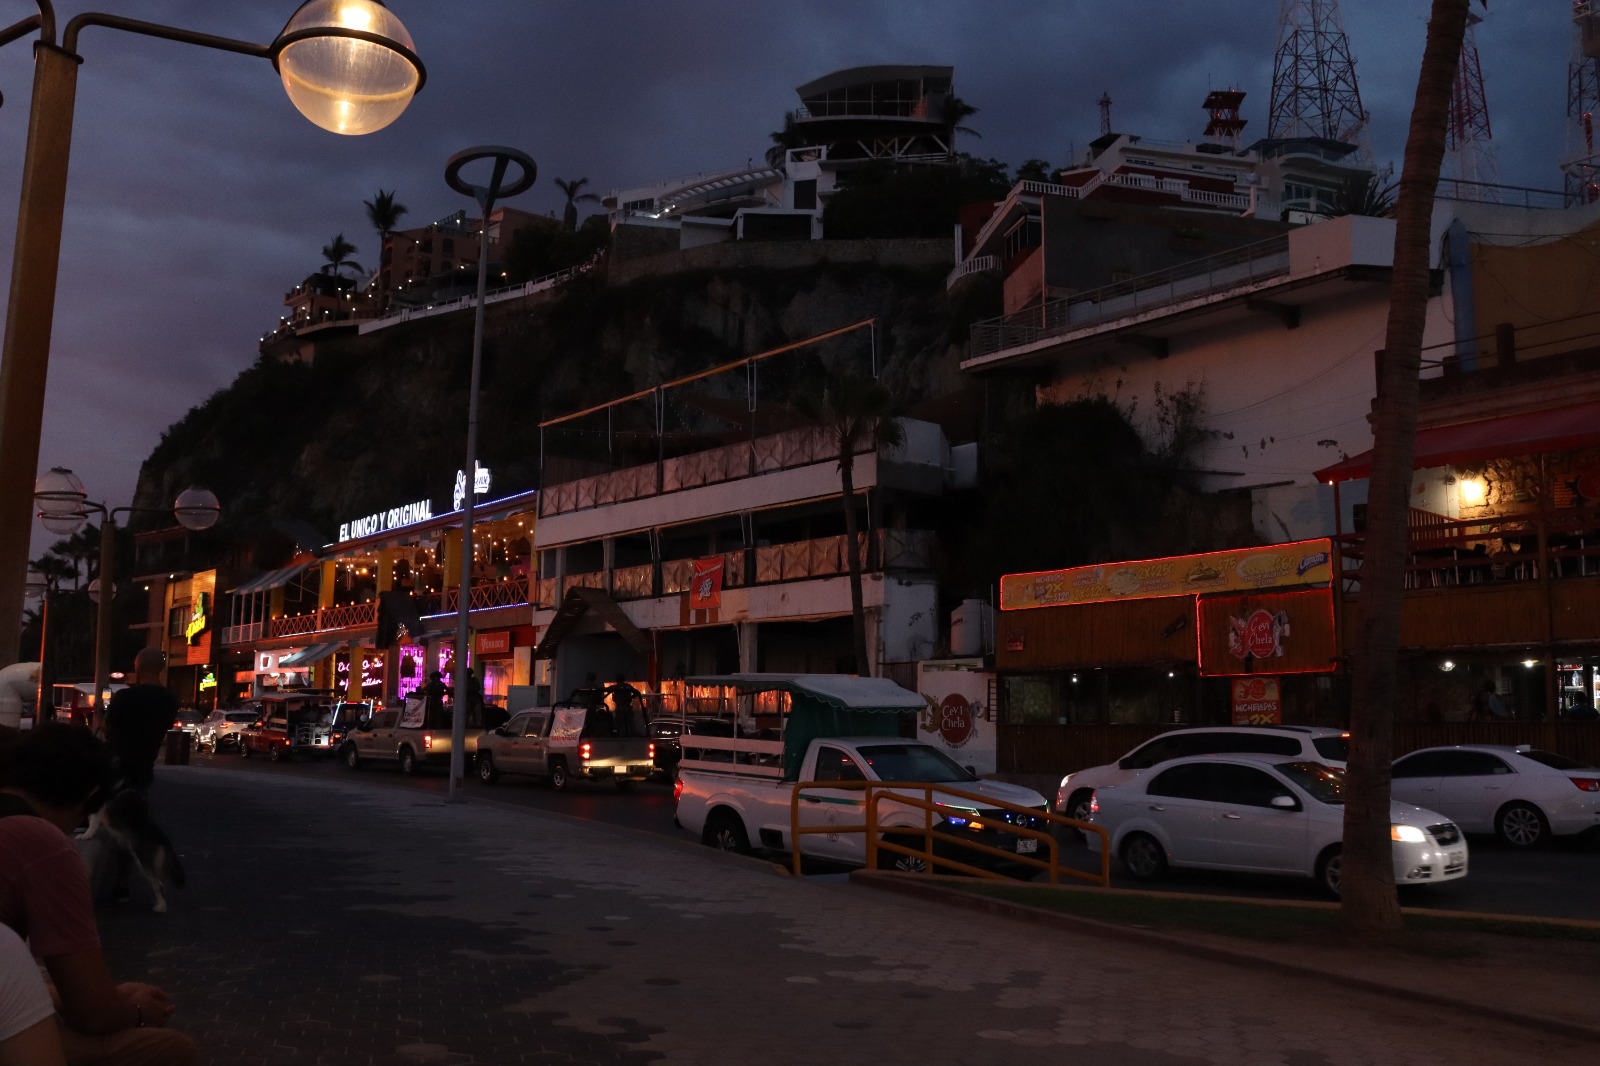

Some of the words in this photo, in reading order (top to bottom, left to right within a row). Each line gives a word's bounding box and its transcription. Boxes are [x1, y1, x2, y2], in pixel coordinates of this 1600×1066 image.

[339, 523, 349, 542] EL
[351, 514, 378, 539] UNICO
[380, 512, 386, 530] Y
[387, 499, 432, 528] ORIGINAL
[1249, 633, 1272, 646] Chela
[1235, 702, 1277, 712] MICHELADAS
[941, 717, 965, 731] Chela
